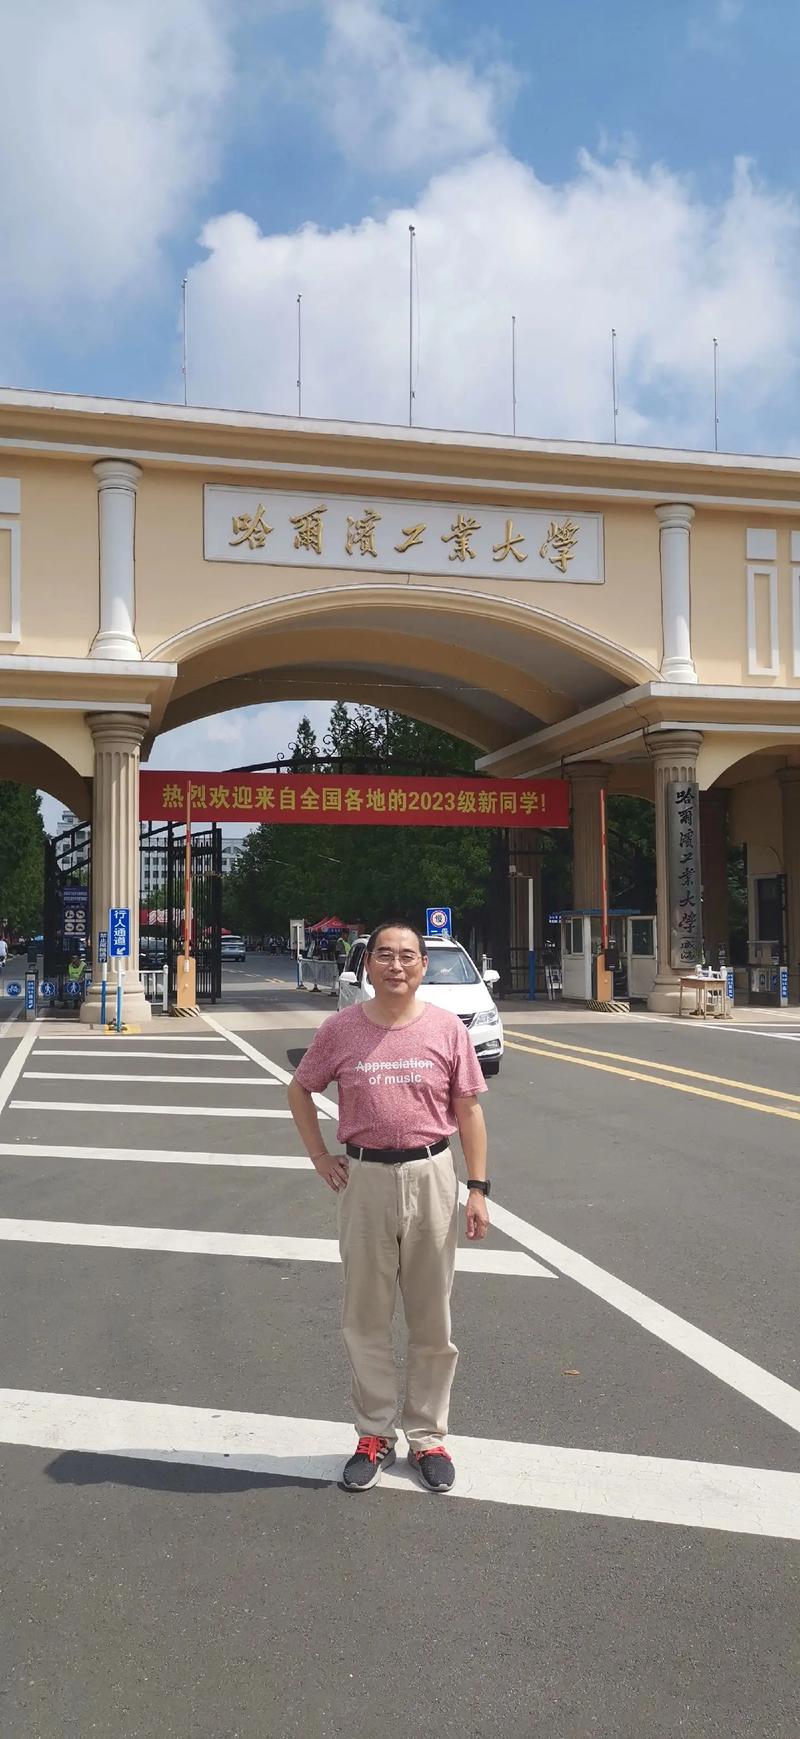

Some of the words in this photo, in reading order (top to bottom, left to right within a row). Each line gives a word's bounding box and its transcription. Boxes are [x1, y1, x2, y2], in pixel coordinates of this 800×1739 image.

[113, 910, 127, 946] 行人通道
[355, 1057, 434, 1073] Appreciation
[368, 1073, 382, 1085] of
[384, 1071, 422, 1085] music
